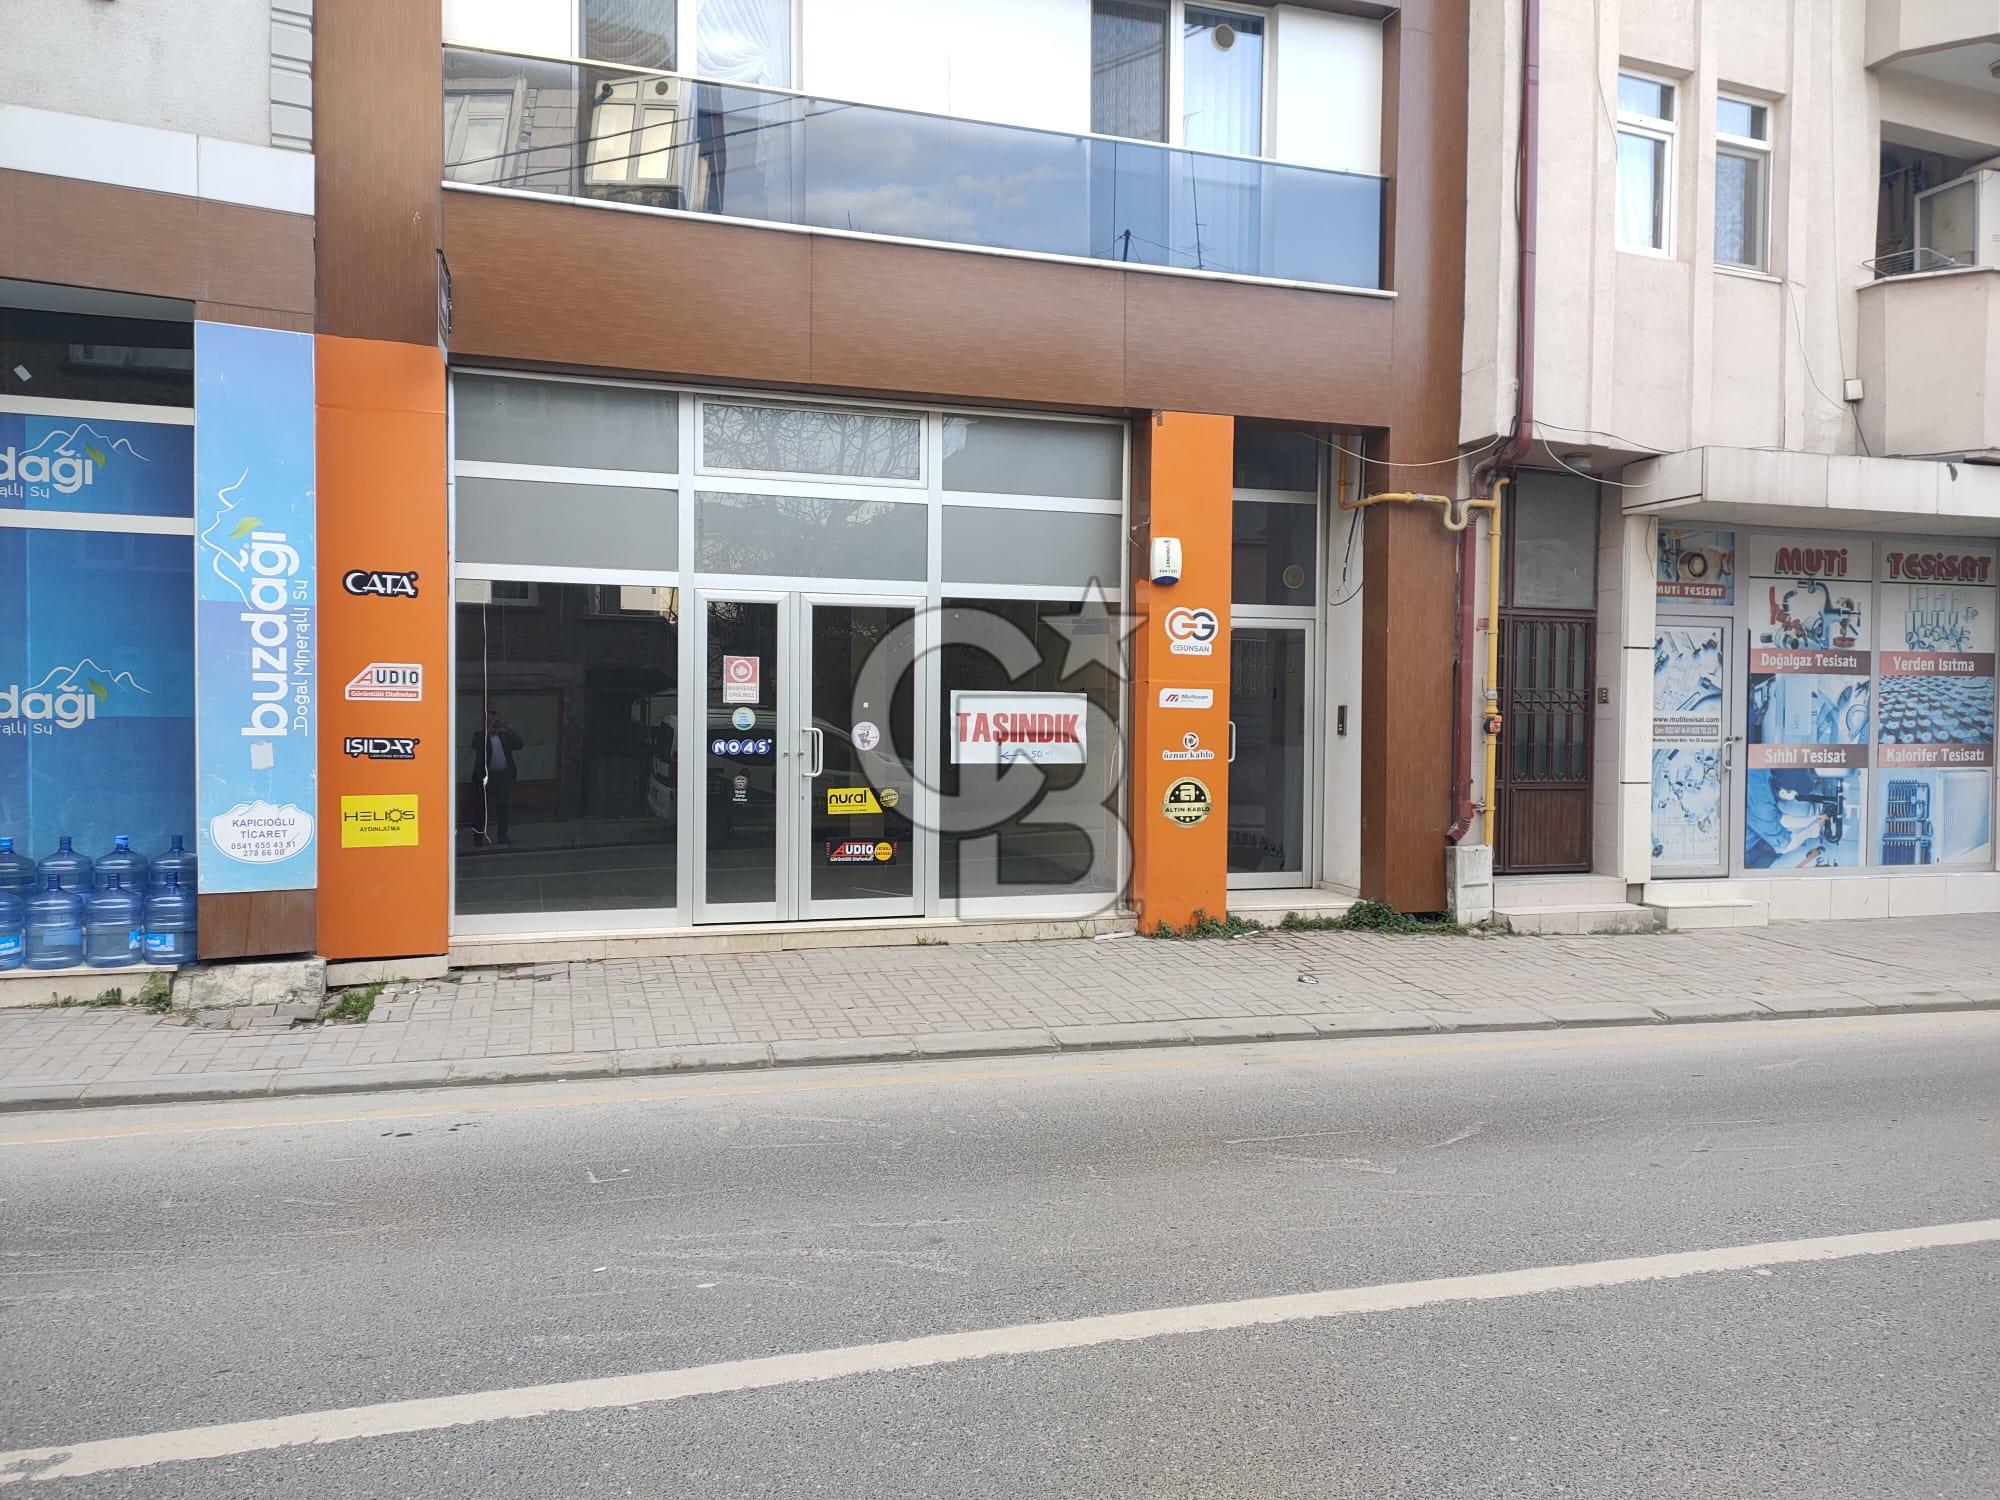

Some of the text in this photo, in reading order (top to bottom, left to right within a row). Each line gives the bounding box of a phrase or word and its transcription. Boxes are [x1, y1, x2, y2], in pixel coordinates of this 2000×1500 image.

[293, 579, 310, 600] Su
[345, 572, 416, 596] CATA
[239, 531, 300, 736] buzdağı
[1760, 652, 1857, 669] Doğalgaz Tesisatı
[1893, 655, 1975, 672] Yerden Isıtma
[356, 668, 420, 686] AUDIO
[290, 680, 310, 736] Doğal
[956, 712, 1080, 746] TAŞINDIK
[346, 738, 415, 757] IŞILDAR
[1163, 749, 1213, 759] öznur kablo
[1886, 747, 1985, 763] Kalorifer Tesisatı
[1801, 750, 1847, 764] Tesisat
[829, 789, 867, 804] nural
[232, 817, 295, 828] KAPICIOĞLU
[344, 808, 416, 823] HELIOS
[831, 843, 873, 856] AUDIO
